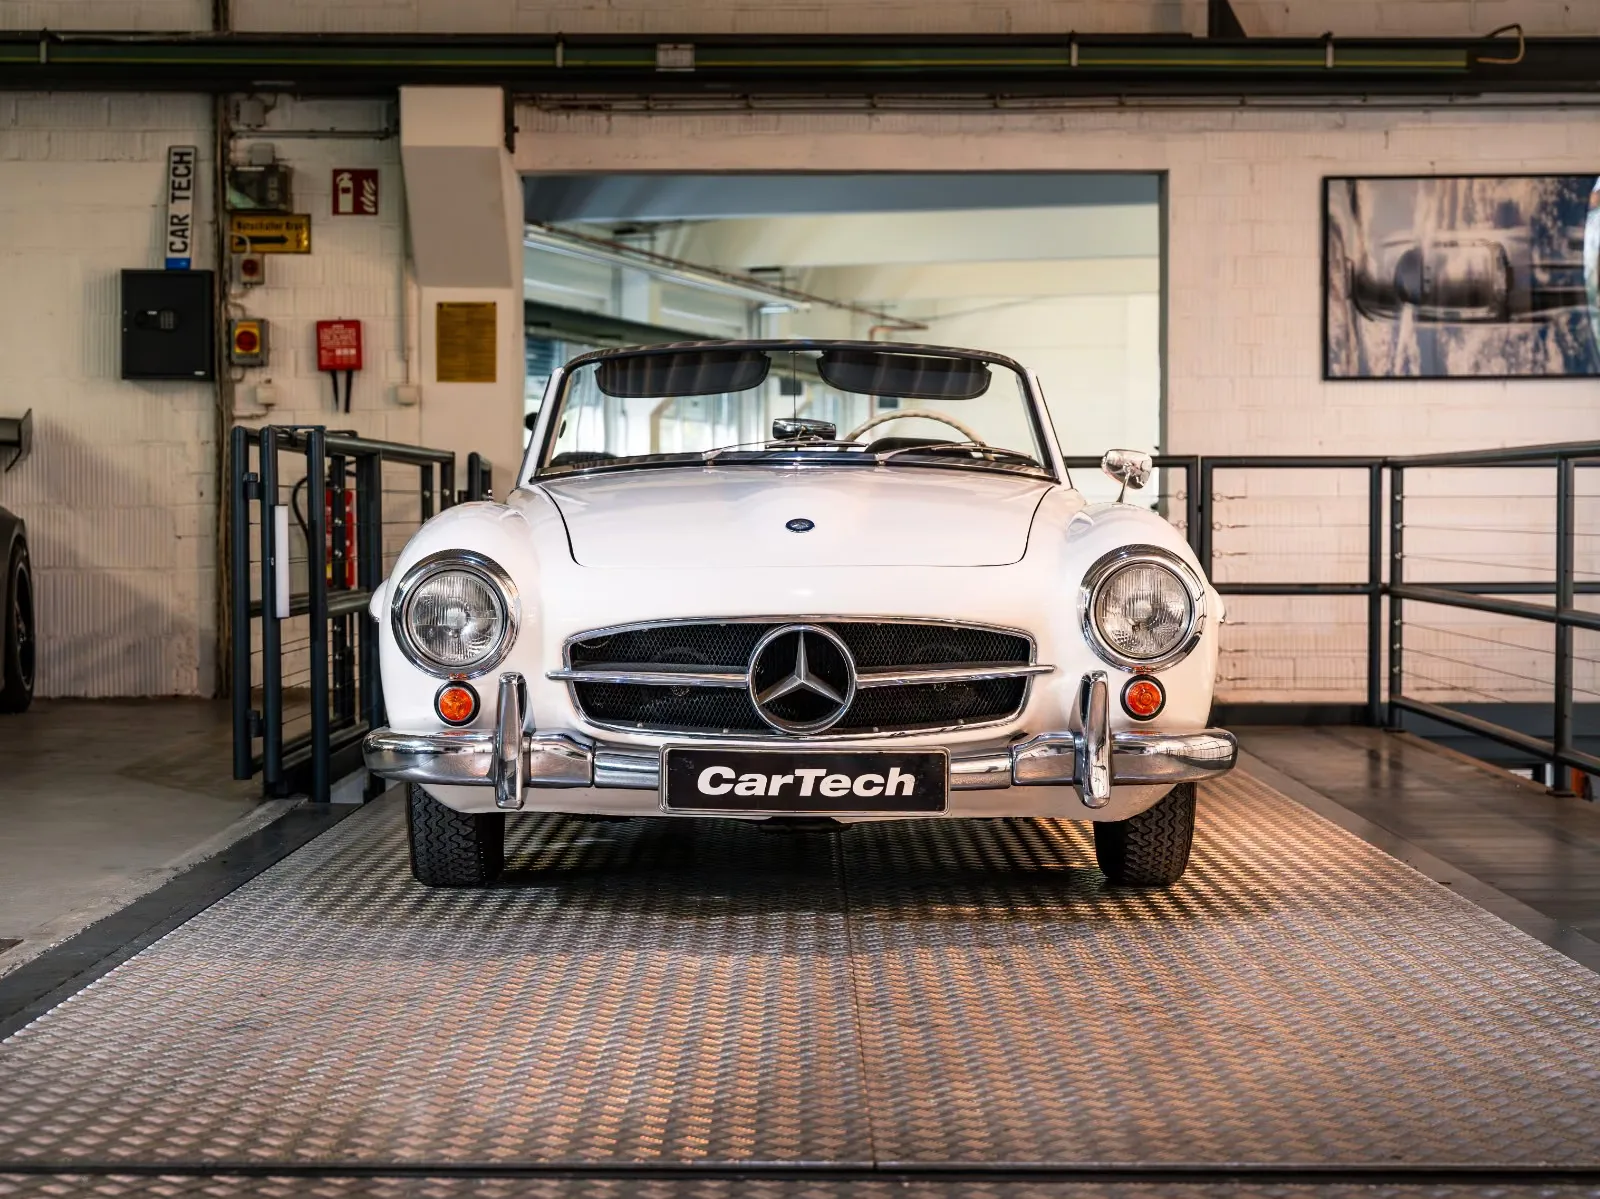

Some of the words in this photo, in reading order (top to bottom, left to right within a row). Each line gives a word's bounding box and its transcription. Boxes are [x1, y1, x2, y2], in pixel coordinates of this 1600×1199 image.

[171, 151, 193, 204] TECH
[169, 213, 190, 253] CAR
[697, 766, 916, 797] CarTech
